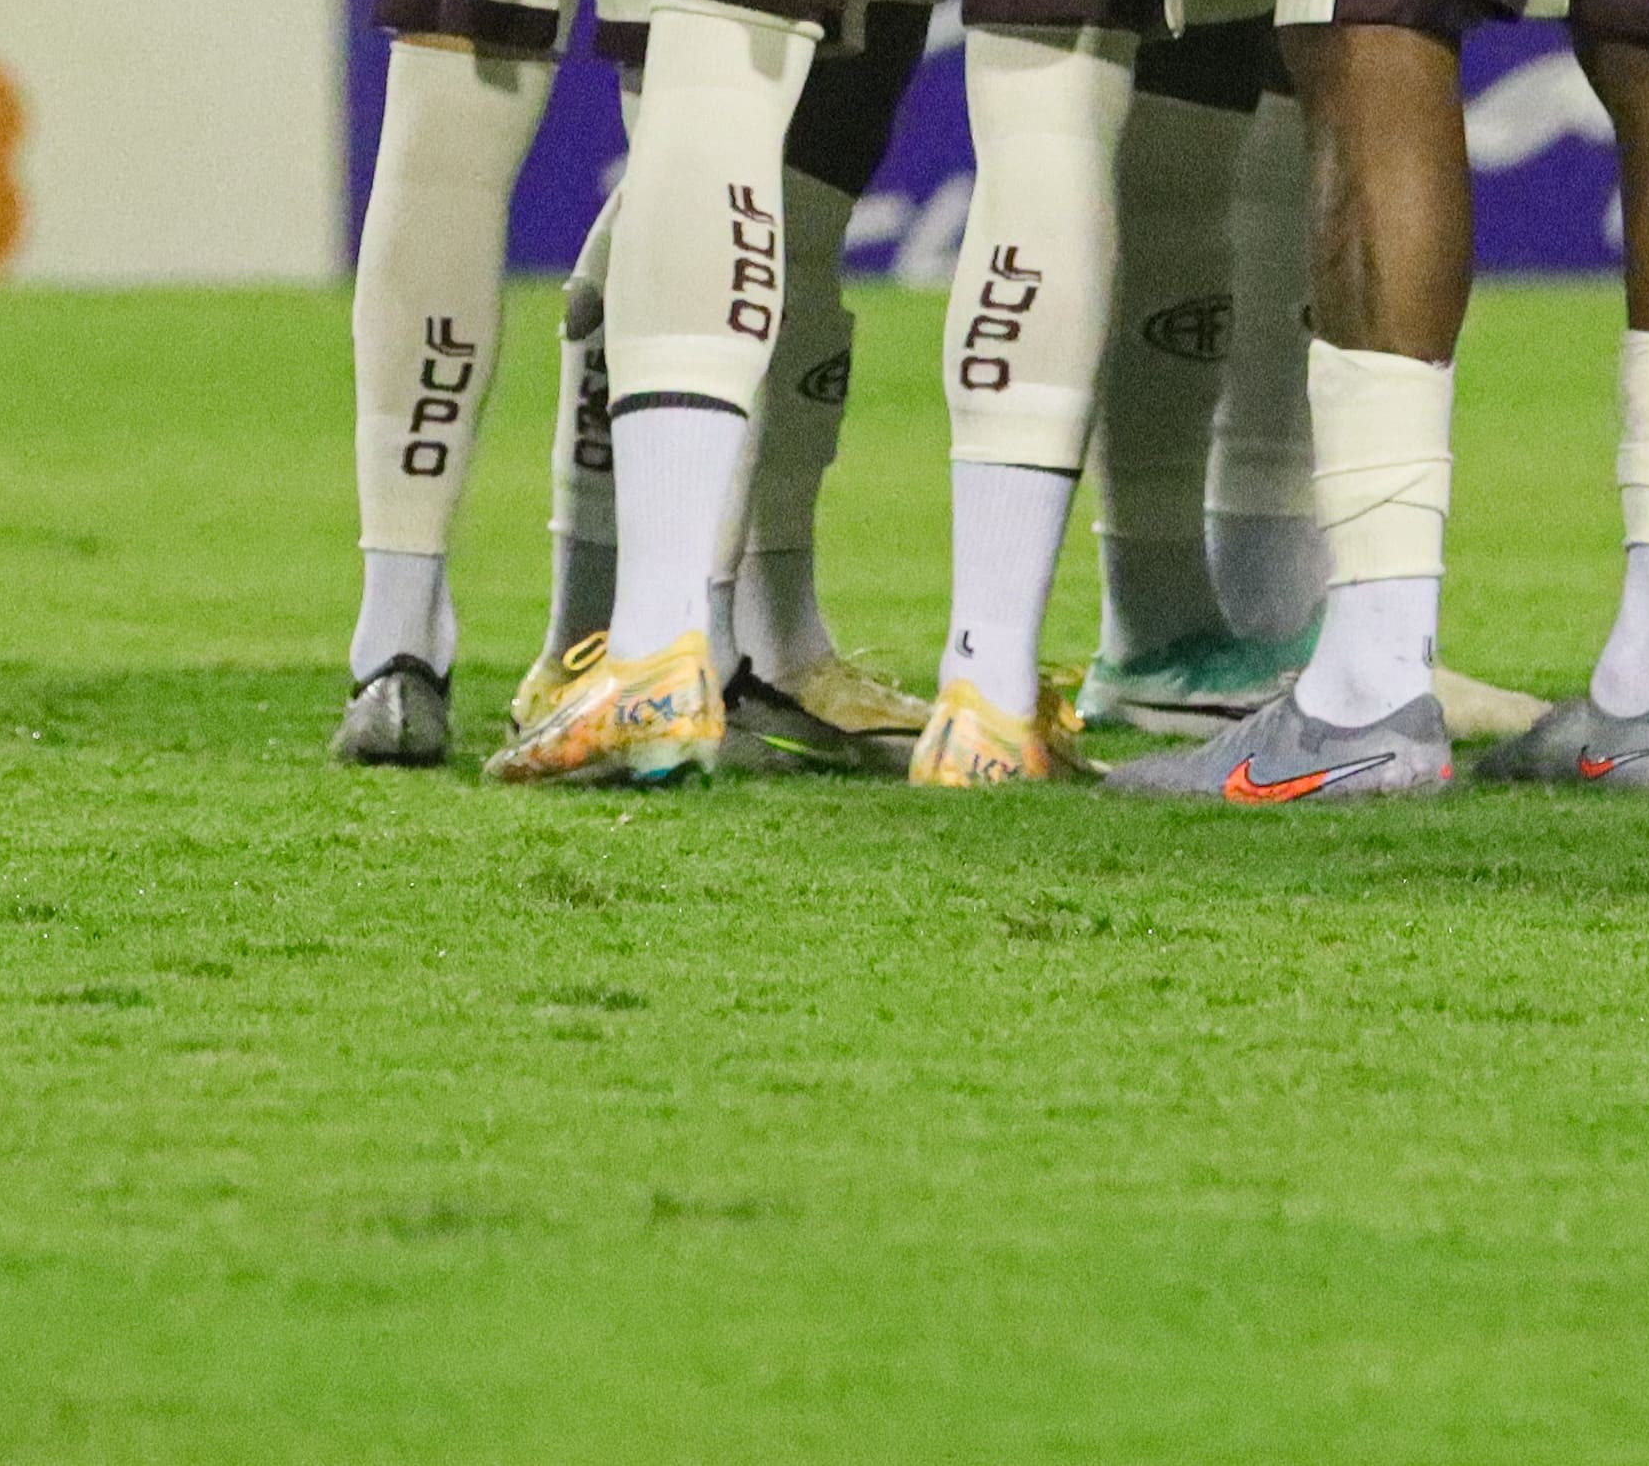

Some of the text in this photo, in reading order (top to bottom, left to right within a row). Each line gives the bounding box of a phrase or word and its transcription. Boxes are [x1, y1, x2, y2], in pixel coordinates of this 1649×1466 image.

[726, 184, 780, 341] LUPO
[960, 245, 1042, 394] LUPO
[403, 315, 476, 478] LUPO
